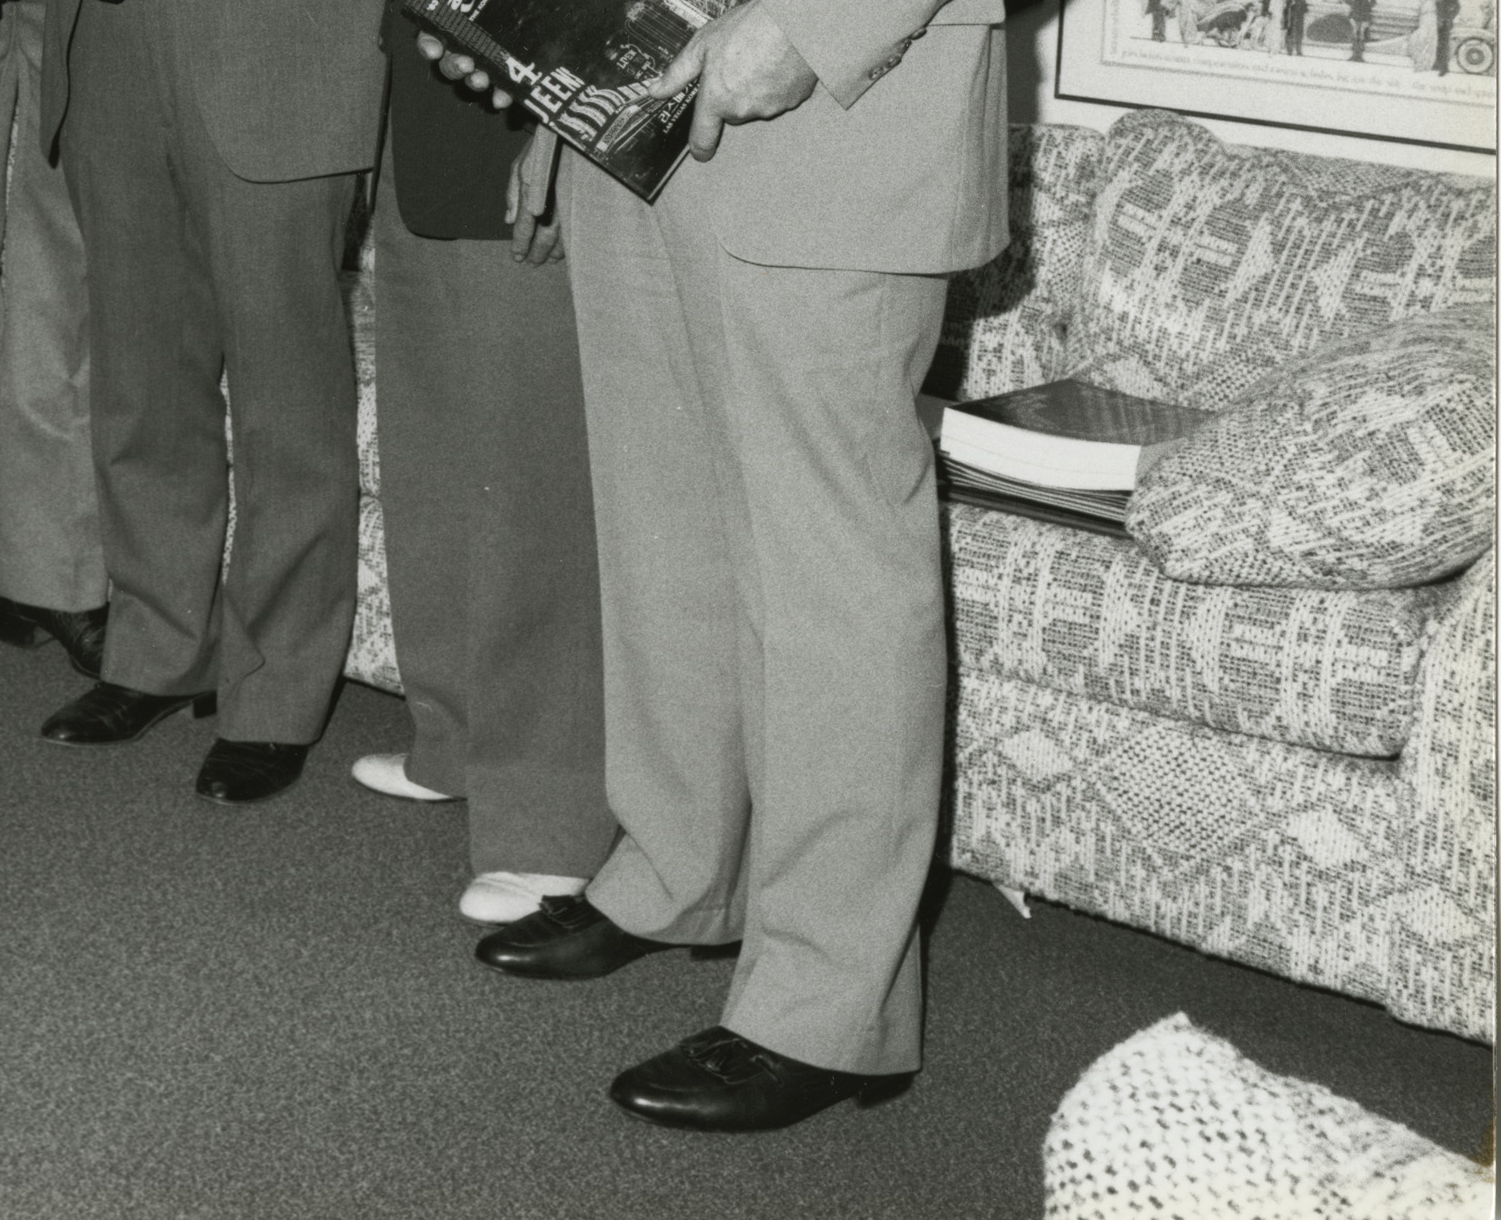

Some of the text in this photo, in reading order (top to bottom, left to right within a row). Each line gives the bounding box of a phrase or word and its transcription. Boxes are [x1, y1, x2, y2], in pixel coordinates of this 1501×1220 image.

[468, 9, 480, 22] THE
[504, 55, 543, 86] 4
[662, 121, 674, 134] LAS
[670, 102, 688, 122] VEGAS
